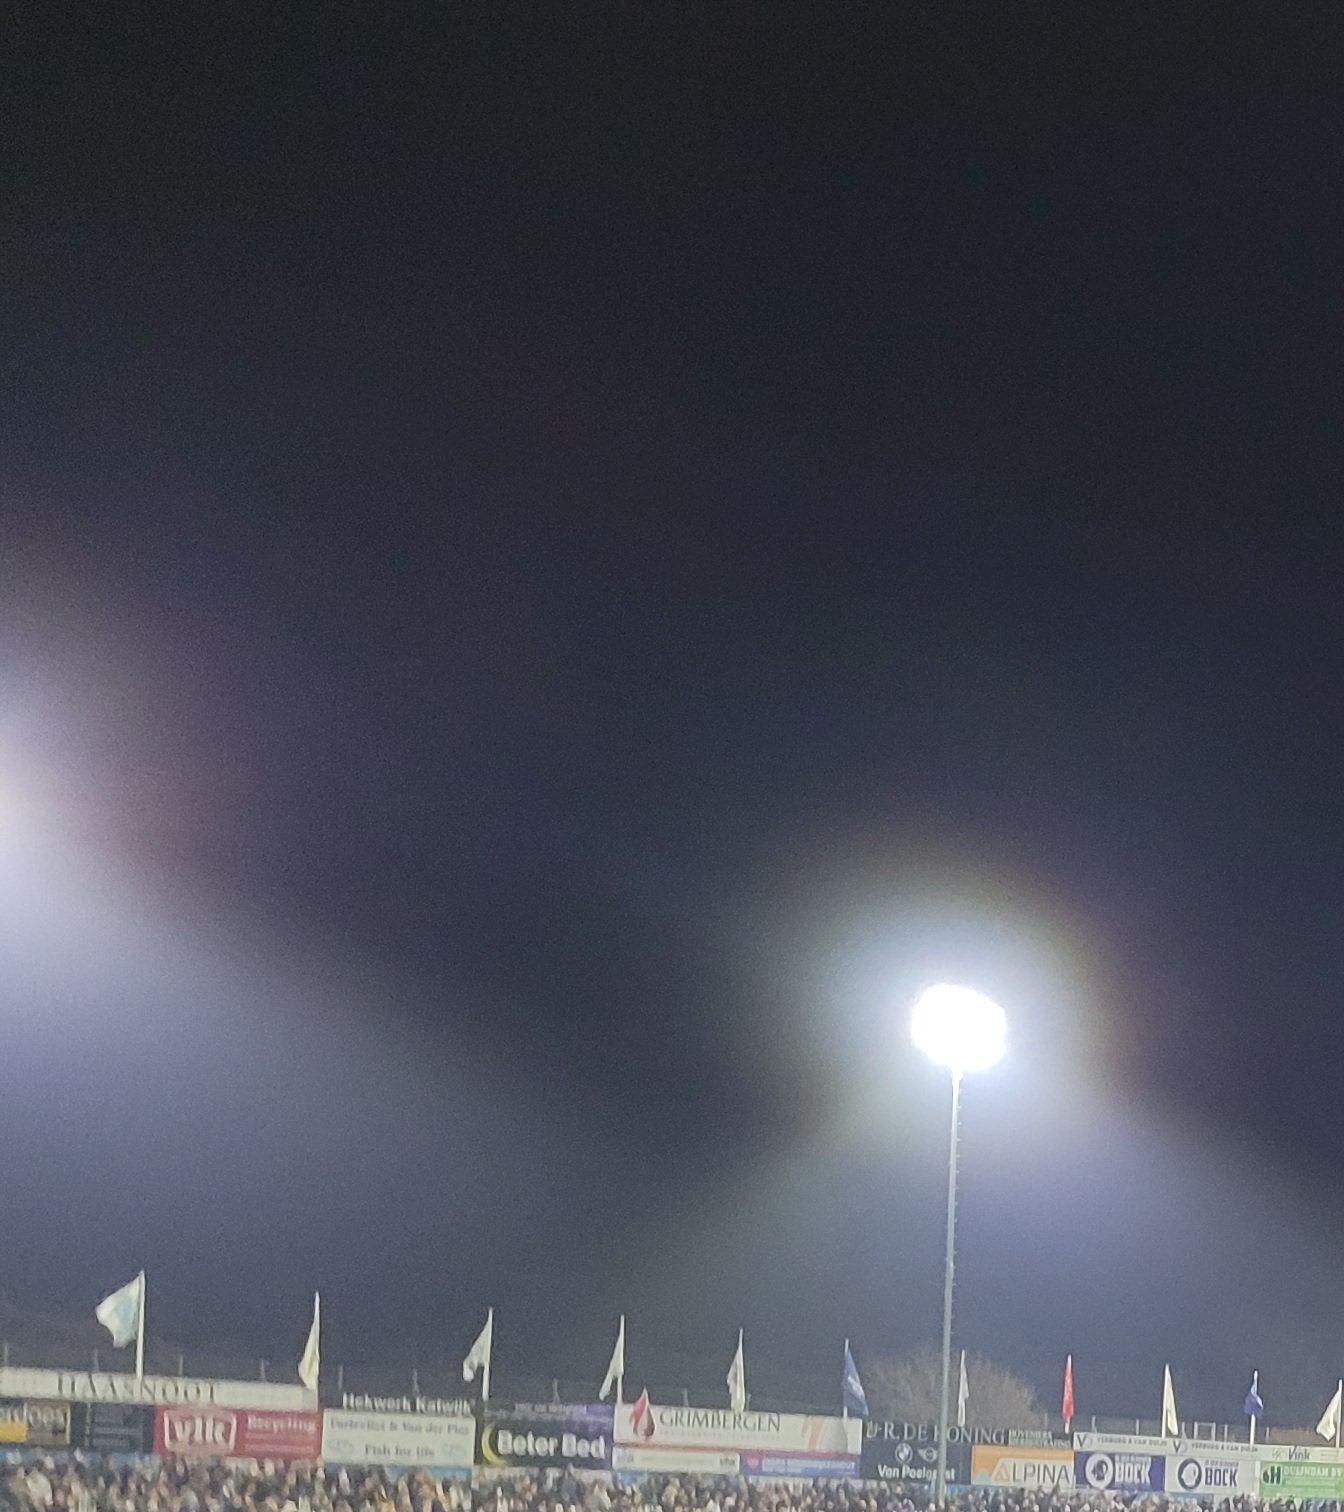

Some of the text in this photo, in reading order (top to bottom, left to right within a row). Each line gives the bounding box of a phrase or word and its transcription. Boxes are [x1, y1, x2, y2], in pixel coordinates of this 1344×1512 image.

[659, 1411, 781, 1433] GRIMBERGEN
[497, 1429, 558, 1457] Beter
[561, 1432, 606, 1459] Bed
[904, 1424, 927, 1441] DE
[933, 1424, 1005, 1445] ONING
[1288, 1446, 1311, 1461] Vink
[877, 1463, 899, 1479] Van
[901, 1464, 956, 1482] Poelgst
[1204, 1465, 1238, 1488] BOCK
